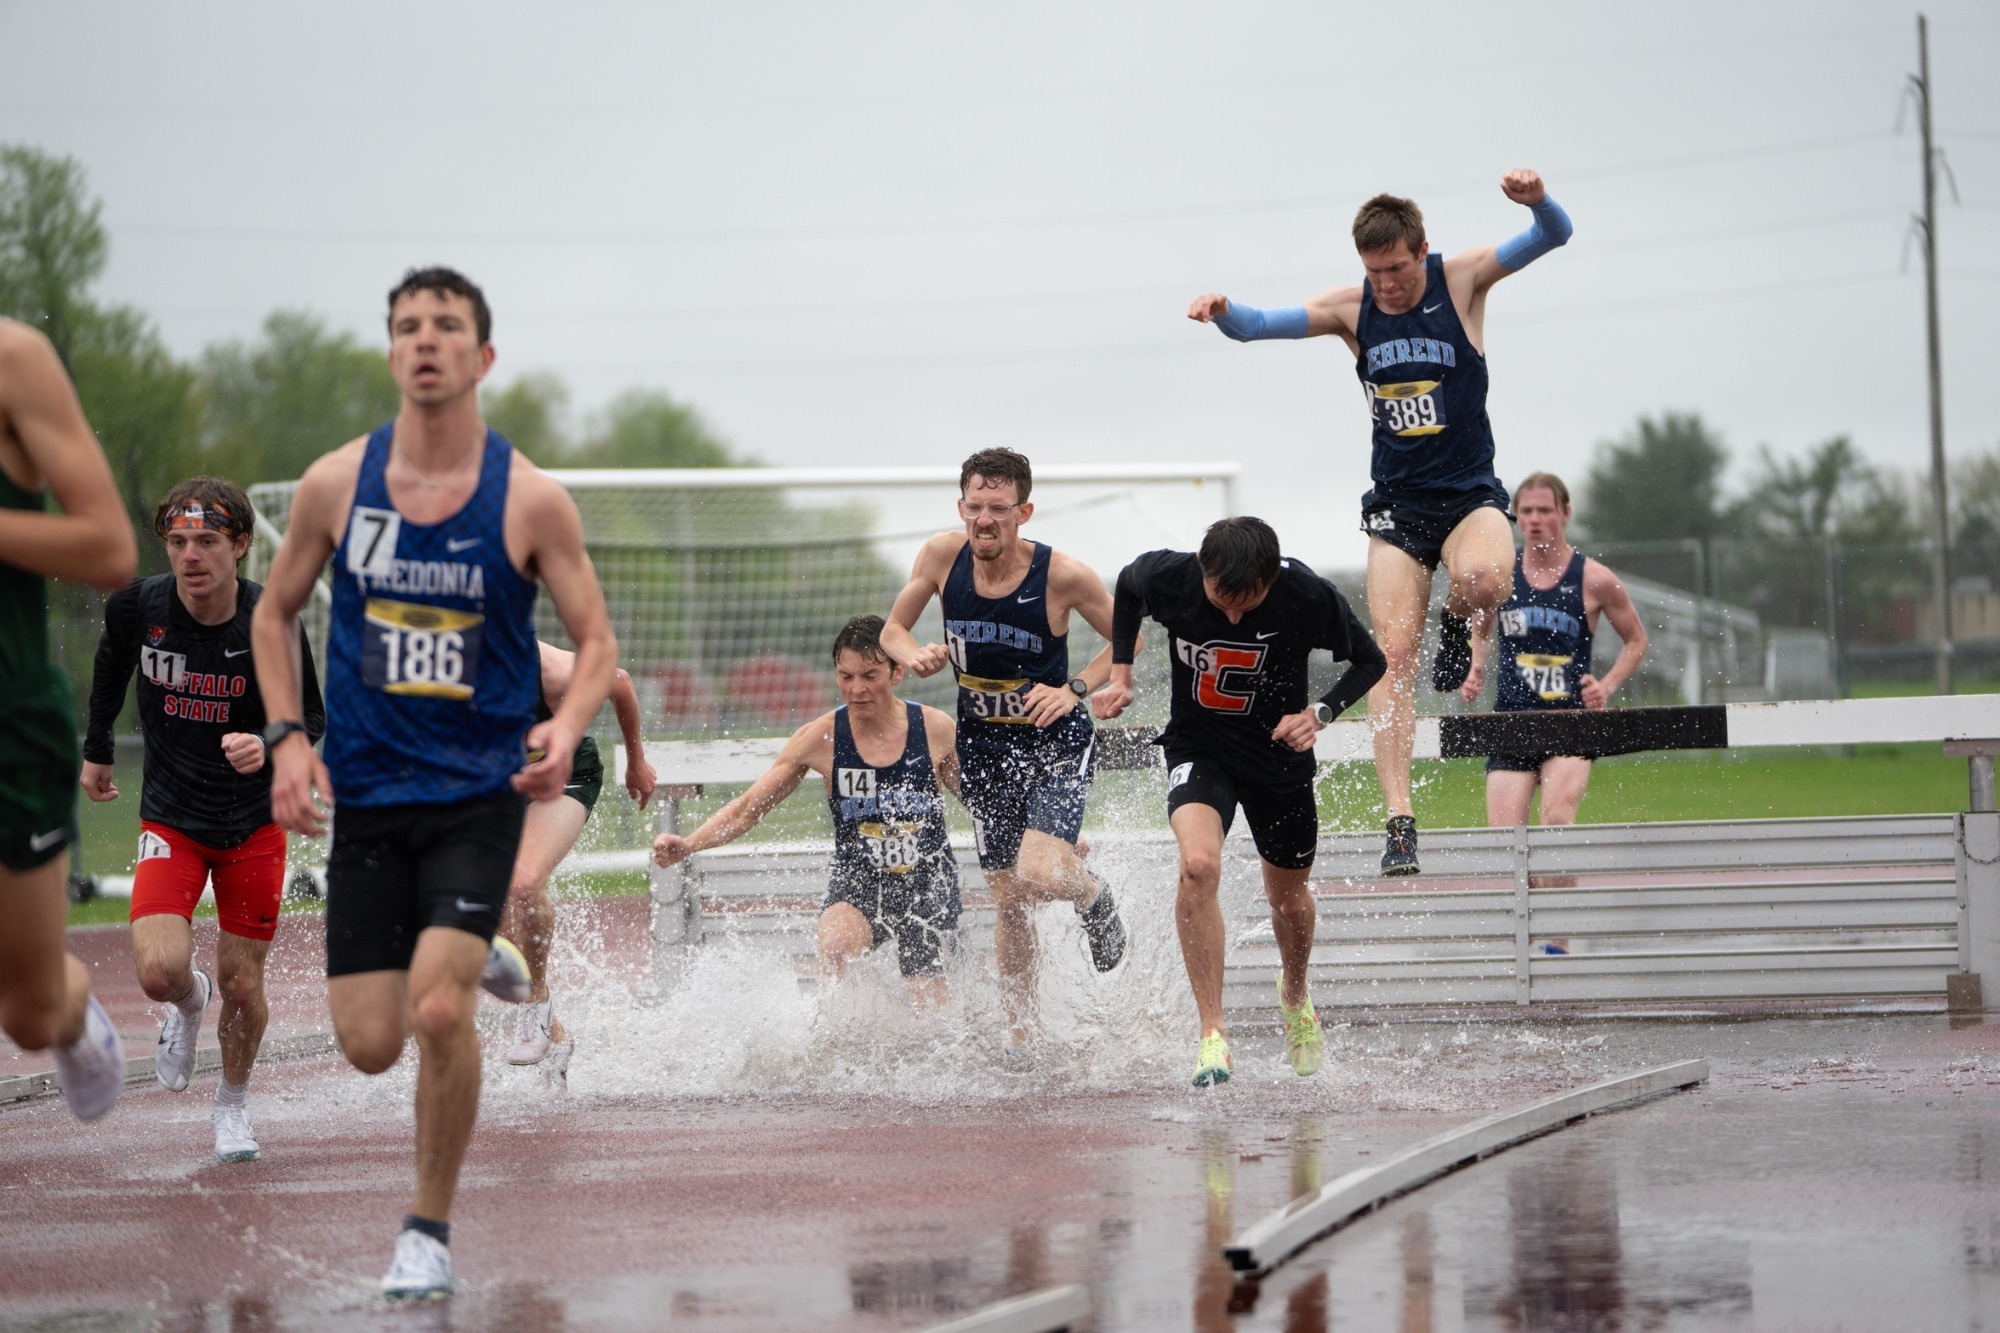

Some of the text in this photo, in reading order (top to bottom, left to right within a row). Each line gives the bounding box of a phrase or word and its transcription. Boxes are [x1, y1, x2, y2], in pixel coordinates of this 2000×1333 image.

[1366, 337, 1456, 376] EHREND
[1385, 394, 1437, 430] 389
[365, 515, 388, 568] 7
[148, 651, 175, 683] 11
[380, 629, 464, 683] 186
[1183, 645, 1209, 672] 16
[1192, 640, 1269, 715] C
[1522, 666, 1565, 694] 376
[164, 694, 230, 723] STATE
[970, 691, 1025, 718] 378
[844, 770, 869, 796] 14
[866, 836, 920, 868] 388
